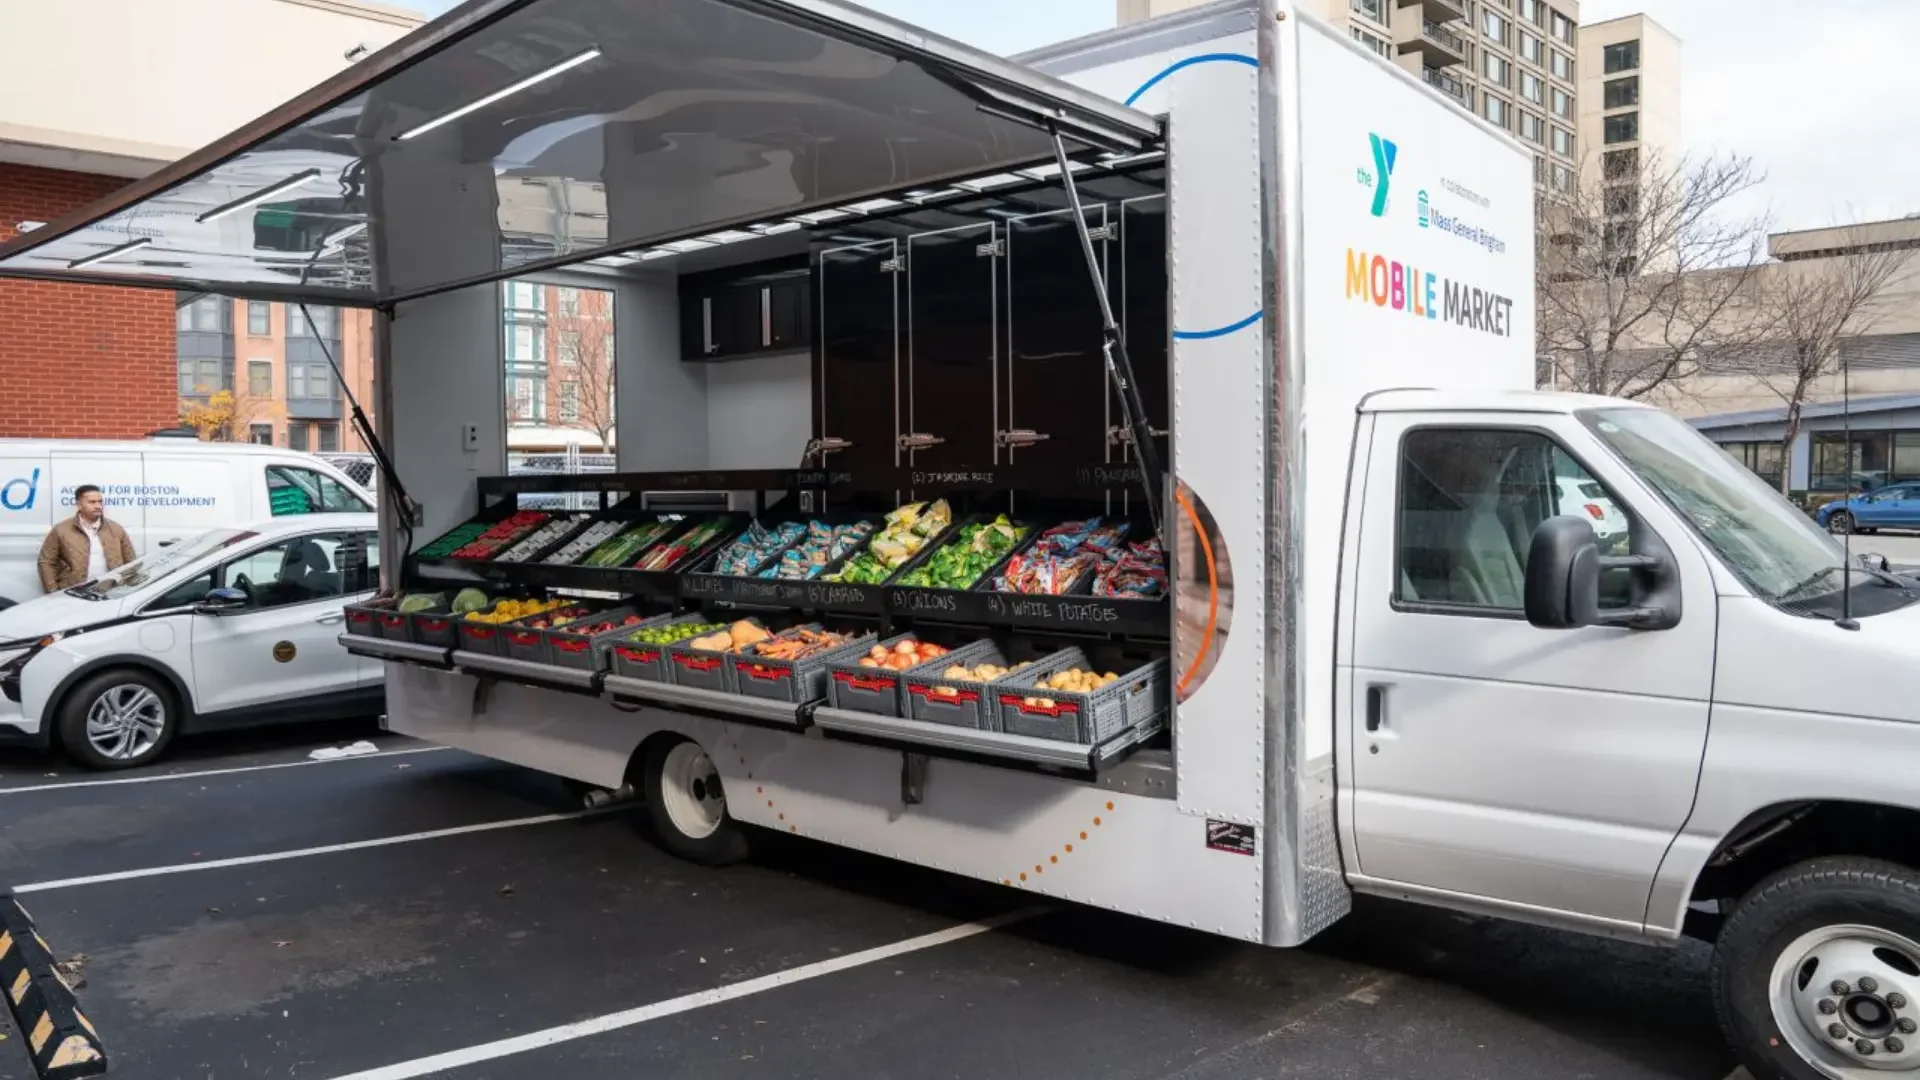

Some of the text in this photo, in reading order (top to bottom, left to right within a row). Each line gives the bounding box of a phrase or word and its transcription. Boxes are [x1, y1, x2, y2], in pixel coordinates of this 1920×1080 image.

[1357, 167, 1372, 187] the
[1431, 207, 1506, 254] Mass General Brigham
[1346, 247, 1513, 338] MOBILE MARKET
[1, 467, 40, 510] d
[61, 485, 180, 495] ACN FOR BOSTON
[61, 497, 217, 507] CONITY DEVELOPMENT
[1012, 601, 1052, 618] WHITE
[1059, 603, 1119, 622] POTATOES
